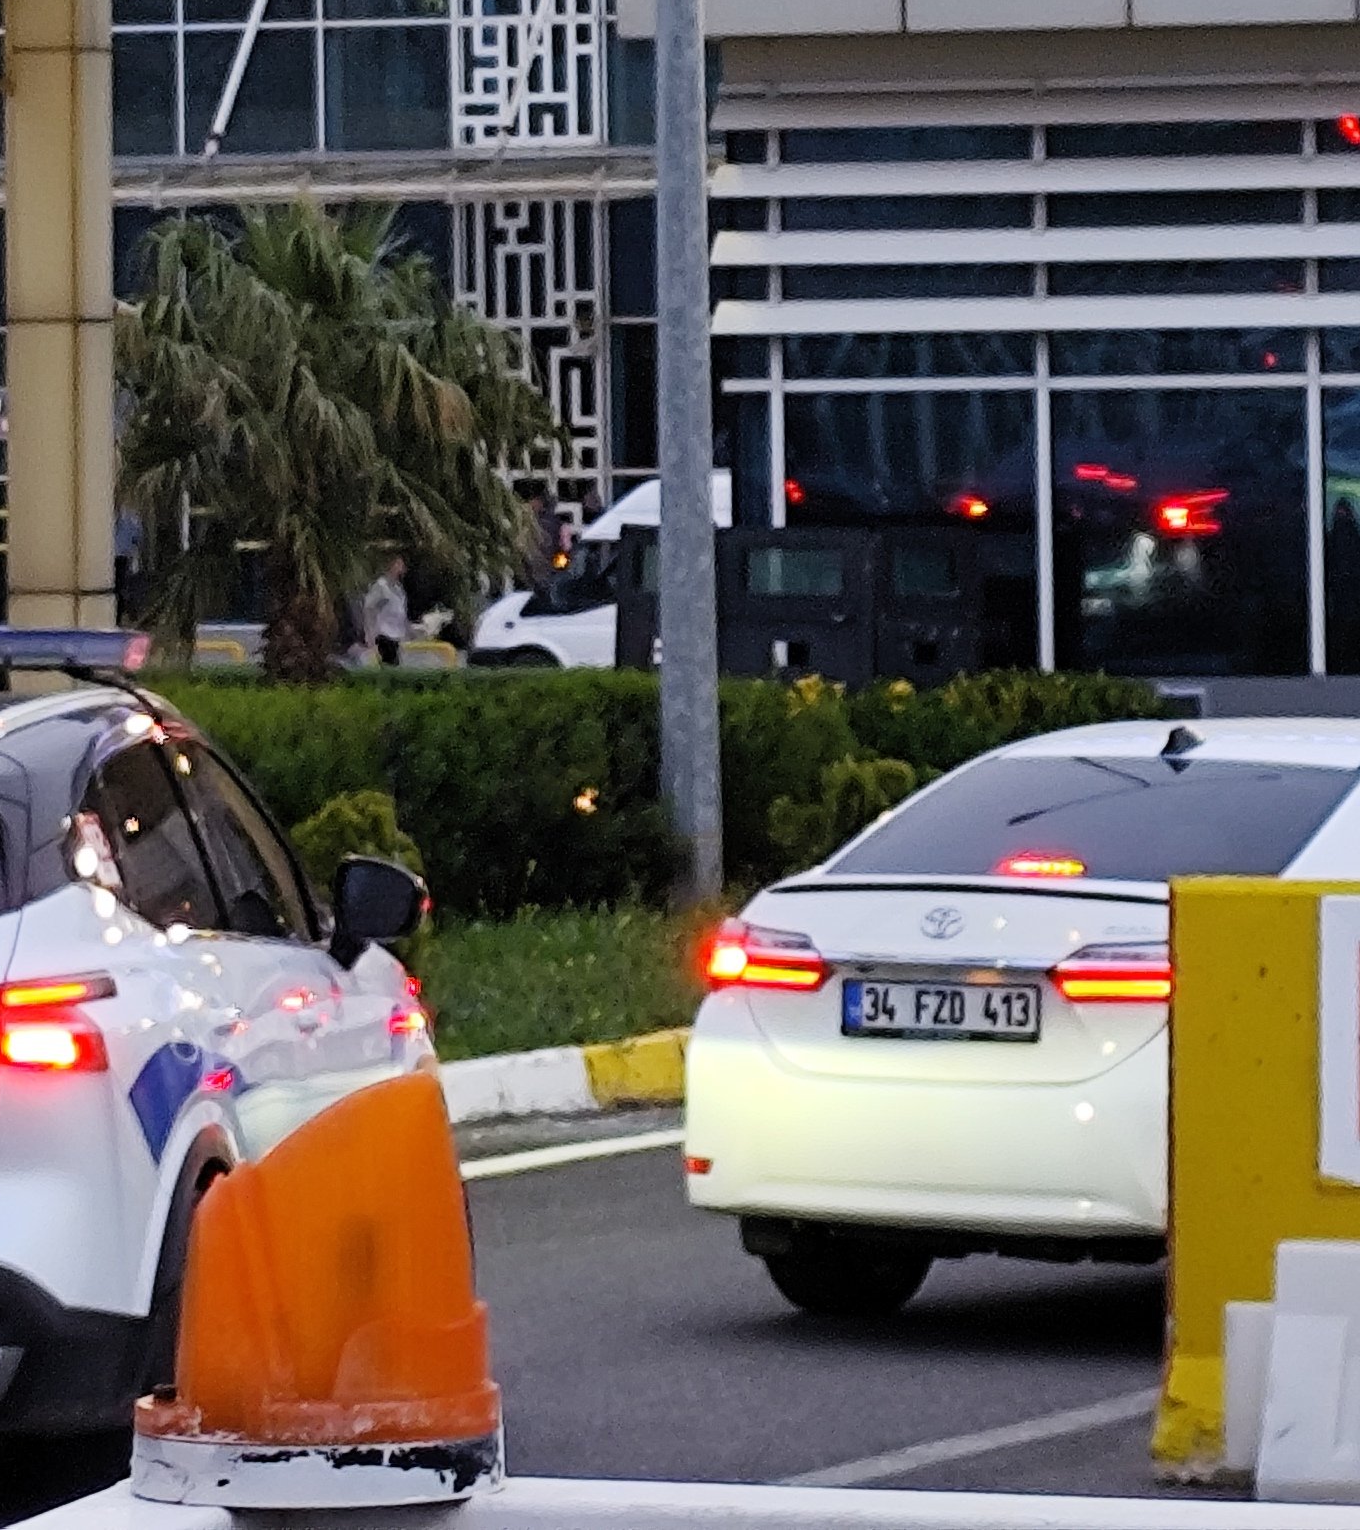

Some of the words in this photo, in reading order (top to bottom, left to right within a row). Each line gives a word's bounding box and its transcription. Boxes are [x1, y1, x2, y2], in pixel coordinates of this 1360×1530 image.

[865, 987, 896, 1022] 34
[915, 991, 965, 1025] FZD
[984, 992, 1031, 1027] 413
